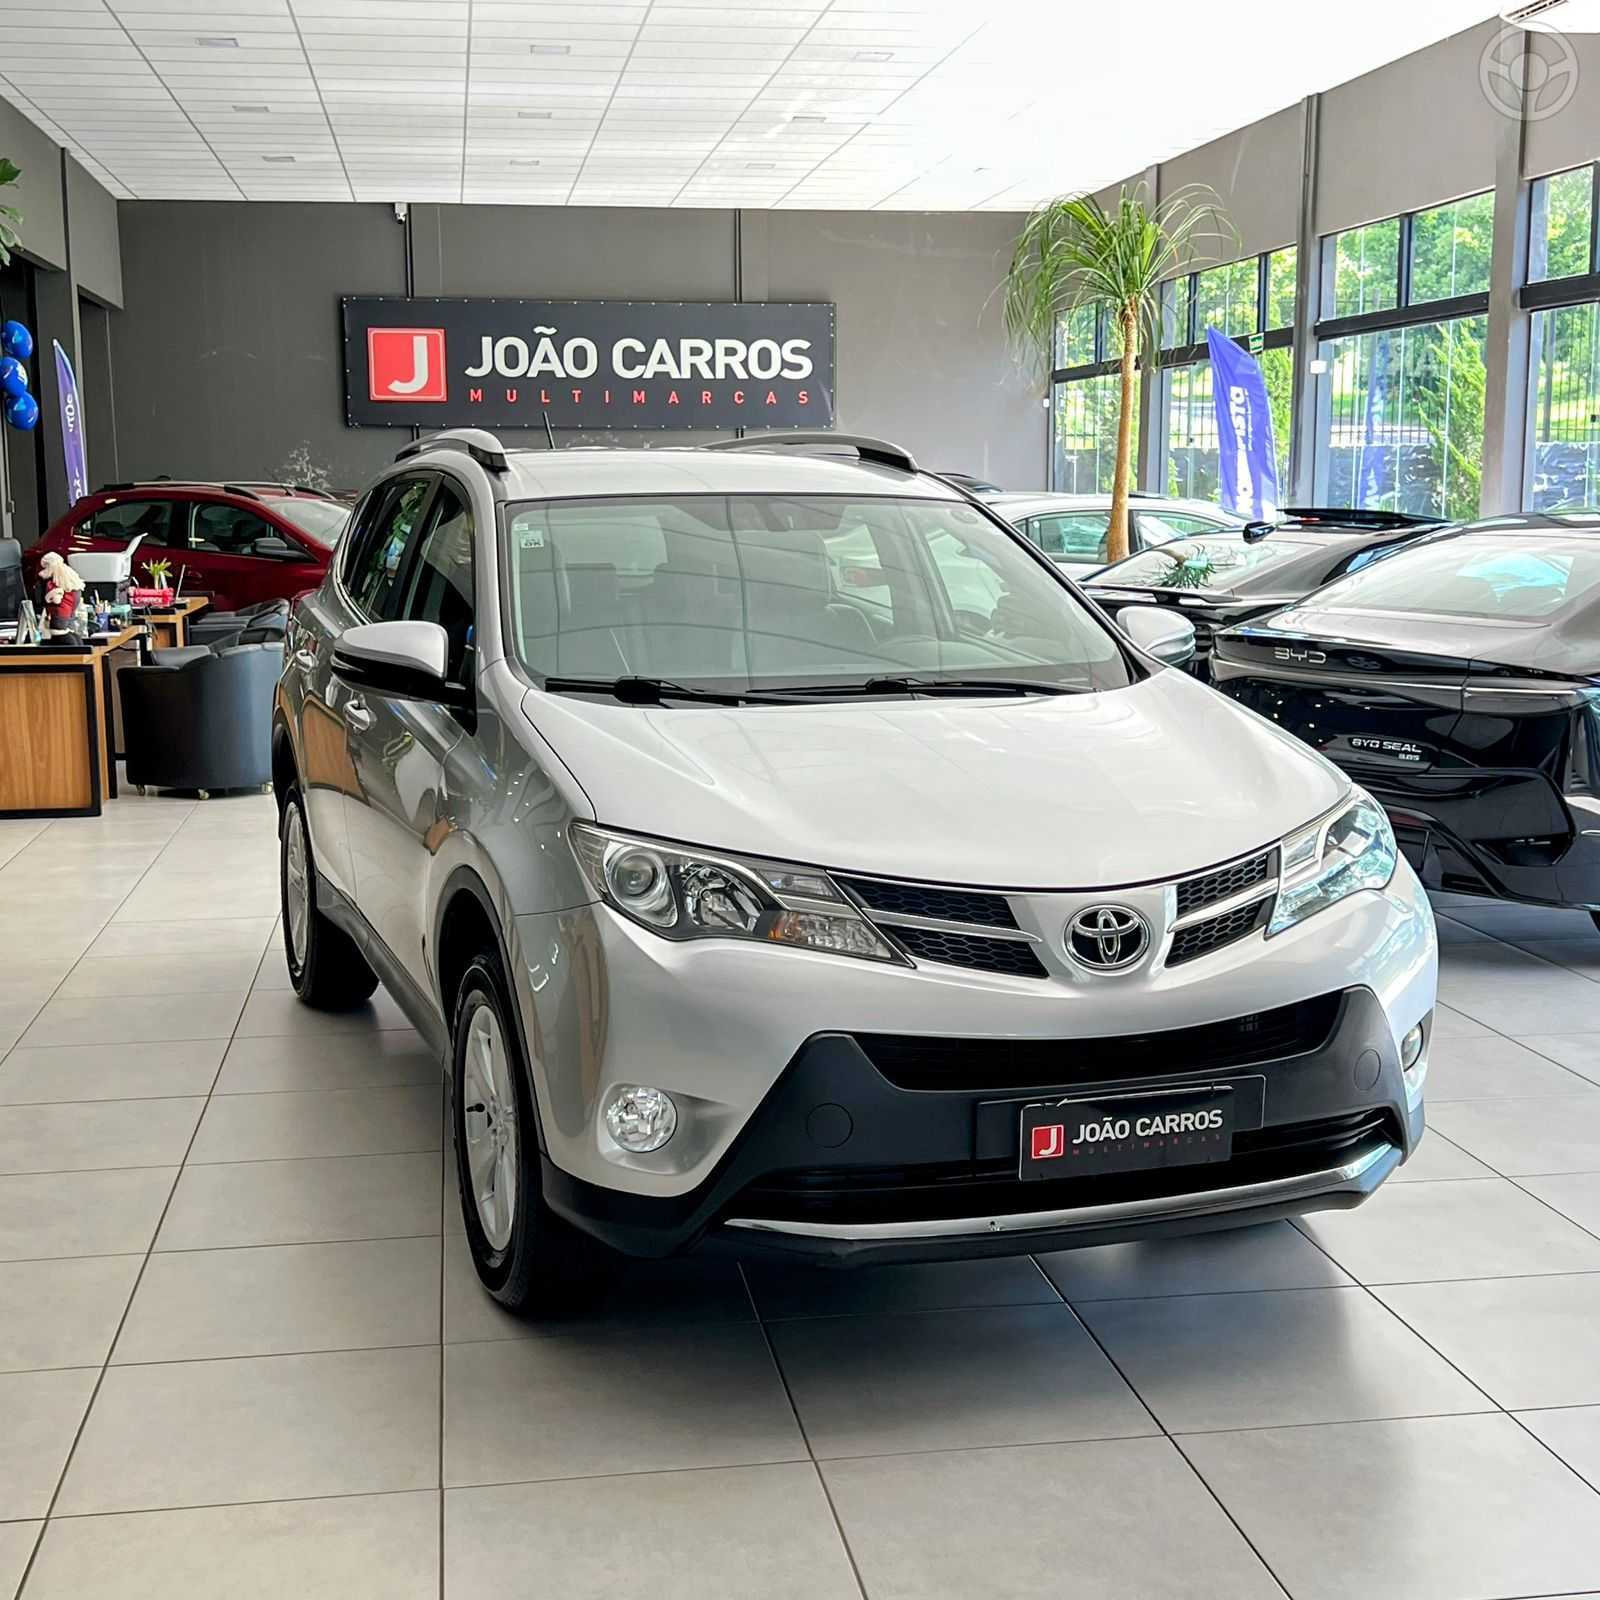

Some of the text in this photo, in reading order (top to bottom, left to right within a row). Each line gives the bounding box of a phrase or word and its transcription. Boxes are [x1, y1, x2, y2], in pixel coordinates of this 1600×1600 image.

[464, 326, 814, 380] JOÃO CARROS
[469, 388, 809, 405] MULTIMARCAS
[1274, 646, 1327, 665] BYD
[1352, 738, 1422, 753] BYD SEAL
[1072, 1109, 1223, 1145] JOÃO CARROS
